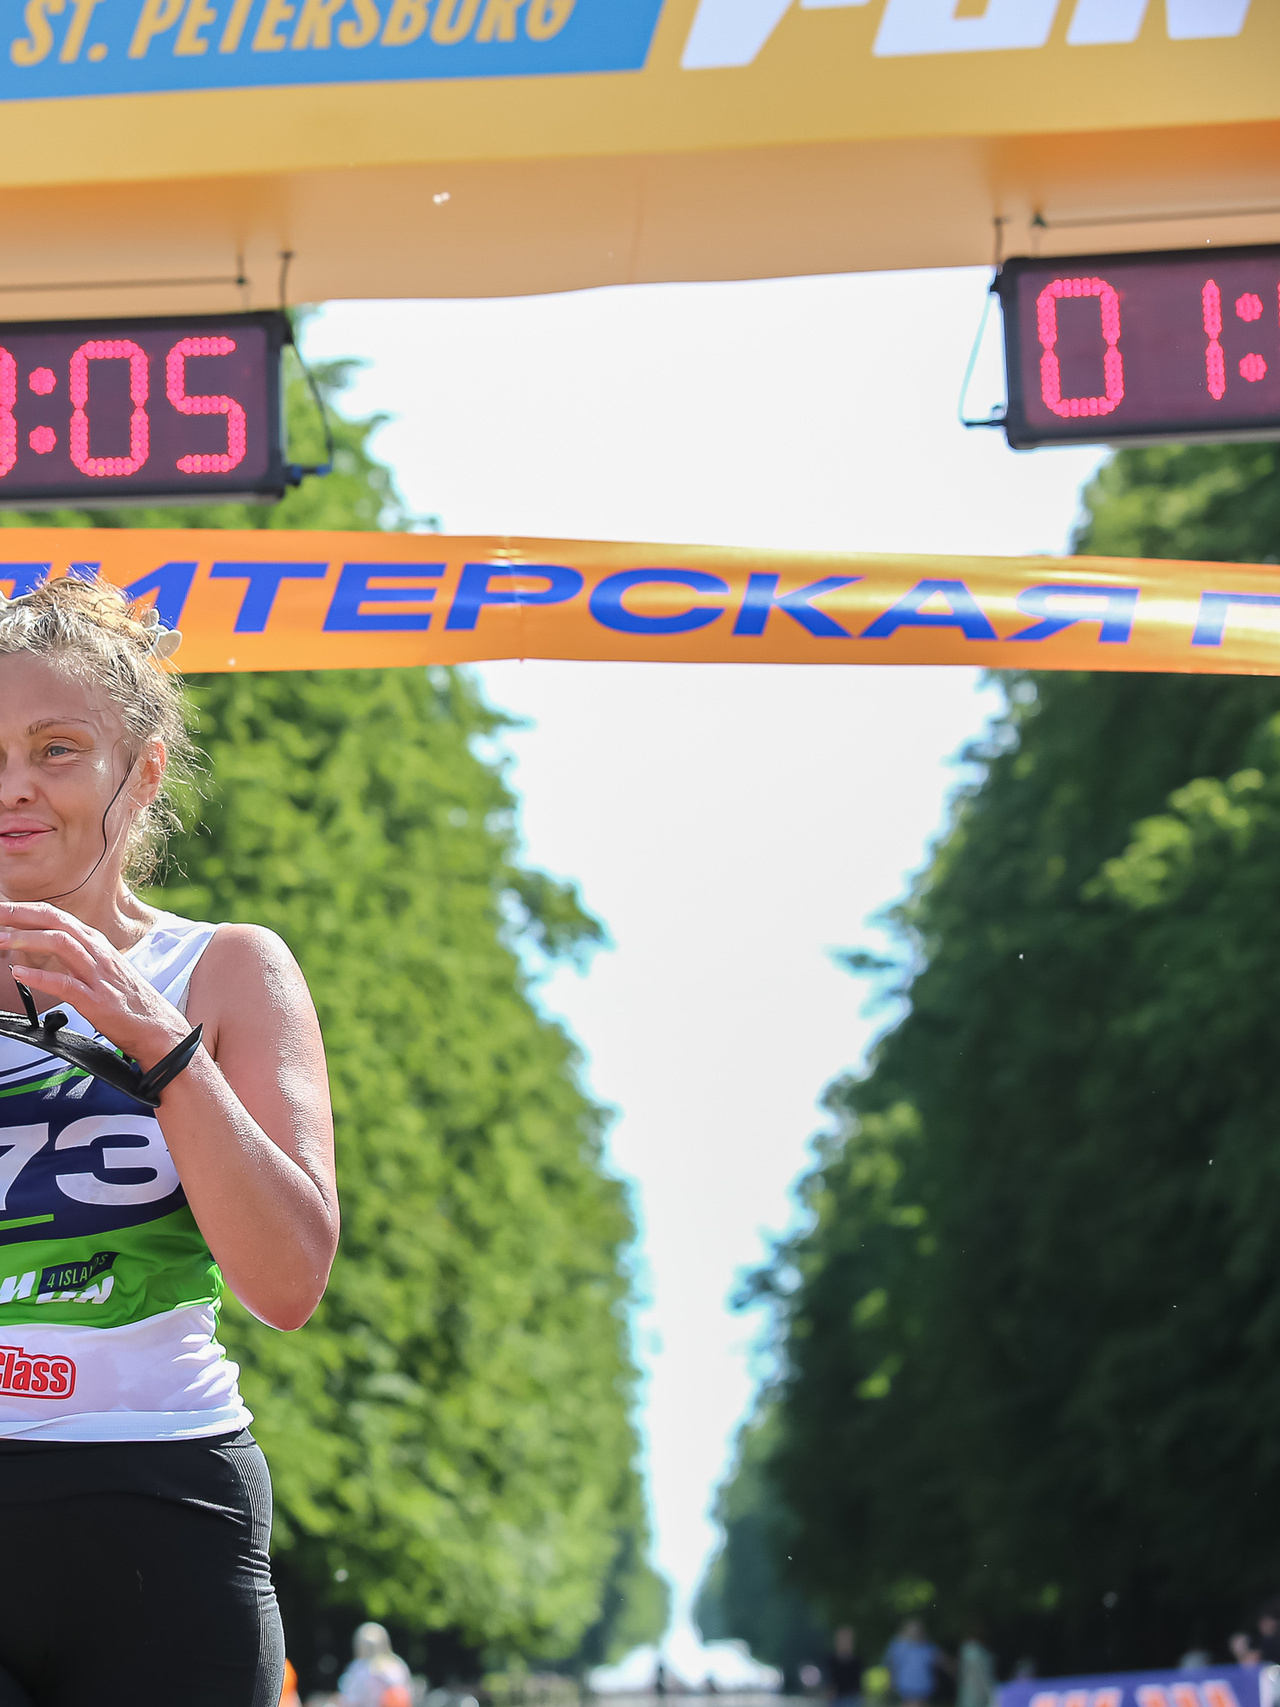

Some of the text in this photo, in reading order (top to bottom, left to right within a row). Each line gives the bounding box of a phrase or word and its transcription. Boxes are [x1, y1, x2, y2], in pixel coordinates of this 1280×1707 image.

[10, 0, 577, 66] ST. PETERSBURG
[1036, 277, 1280, 418] 01:
[47, 1254, 108, 1288] 4 ISLAS
